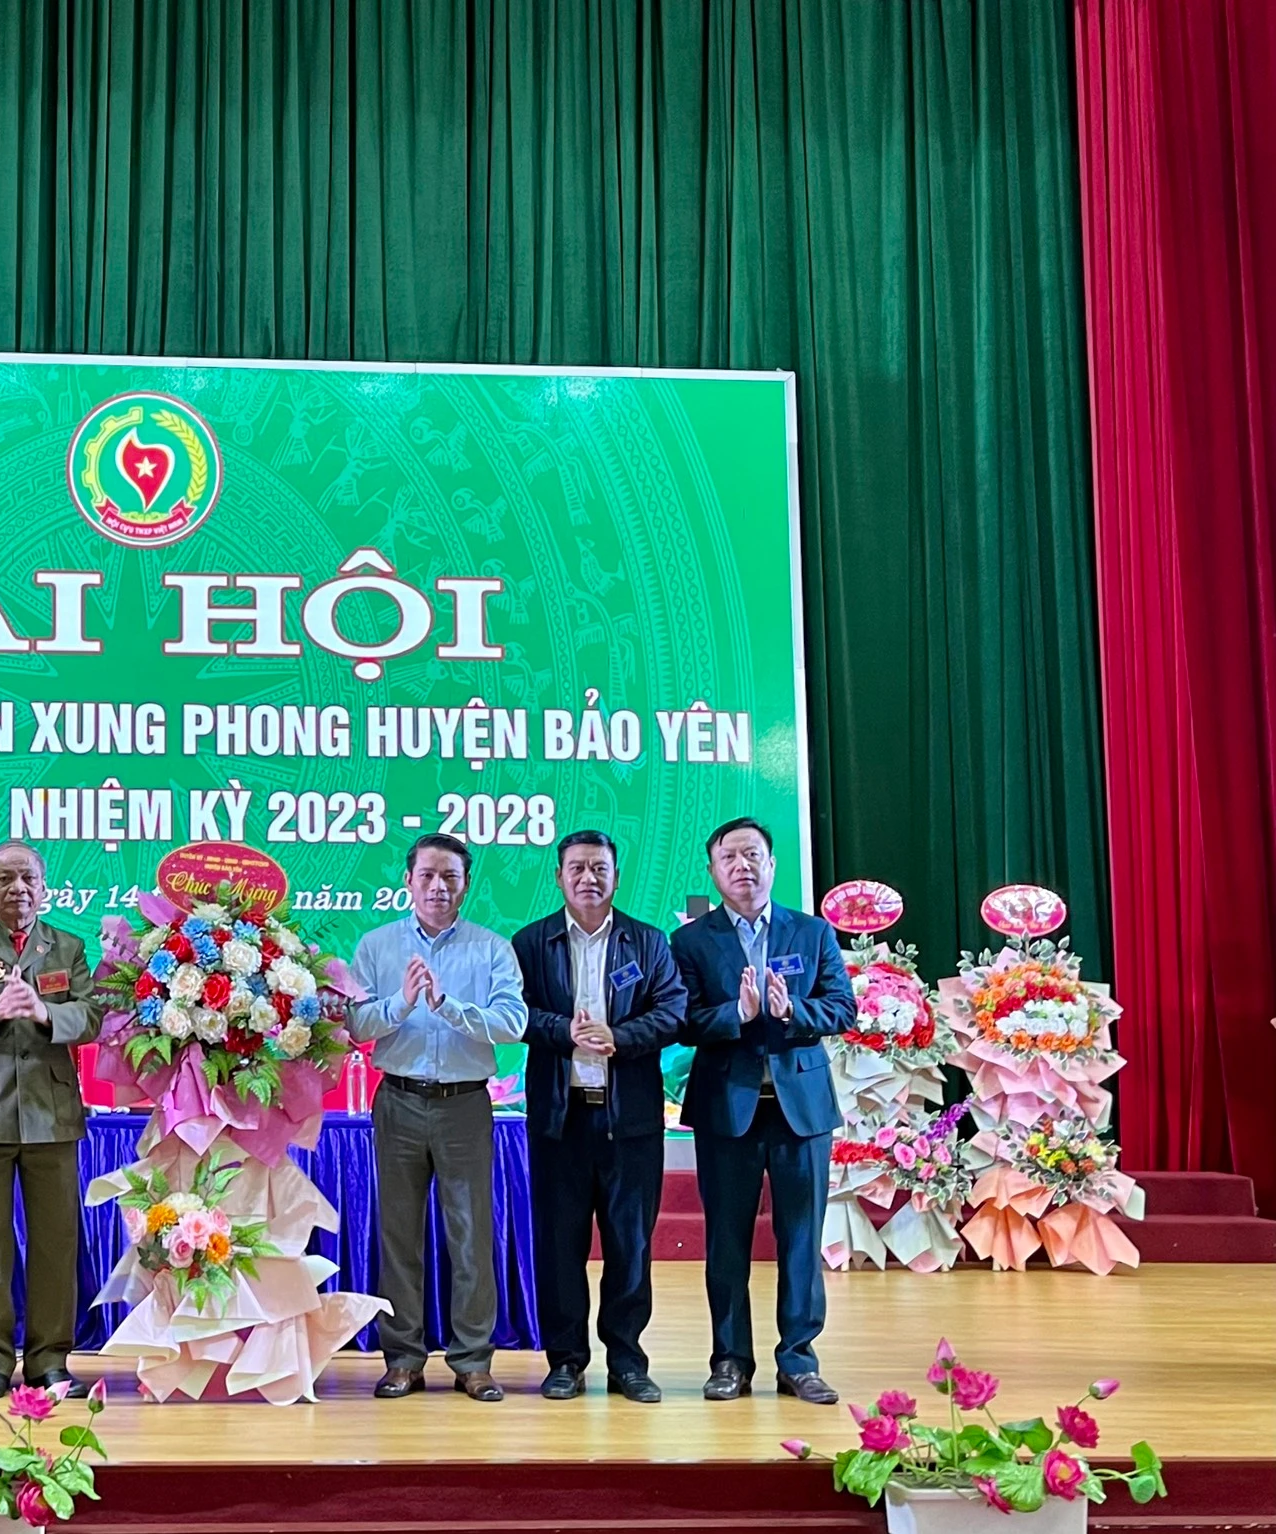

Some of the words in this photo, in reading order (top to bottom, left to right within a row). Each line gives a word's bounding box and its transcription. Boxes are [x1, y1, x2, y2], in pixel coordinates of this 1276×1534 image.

[162, 546, 505, 681] HỘI
[30, 702, 165, 755] XUNG
[183, 704, 349, 757] PHONG
[367, 697, 527, 770] HUYỆN
[544, 687, 641, 761] BẢO
[655, 700, 751, 763] YÊN
[11, 777, 174, 852] NHIỆM
[189, 779, 252, 842] KỲ
[267, 791, 386, 844] 2023
[403, 815, 421, 828] -
[437, 793, 556, 845] 2028
[36, 880, 98, 915] gày
[105, 885, 139, 908] 14
[166, 871, 212, 895] Chúc
[227, 878, 278, 910] Mừng
[292, 884, 363, 910] năm
[372, 887, 416, 911] 20
